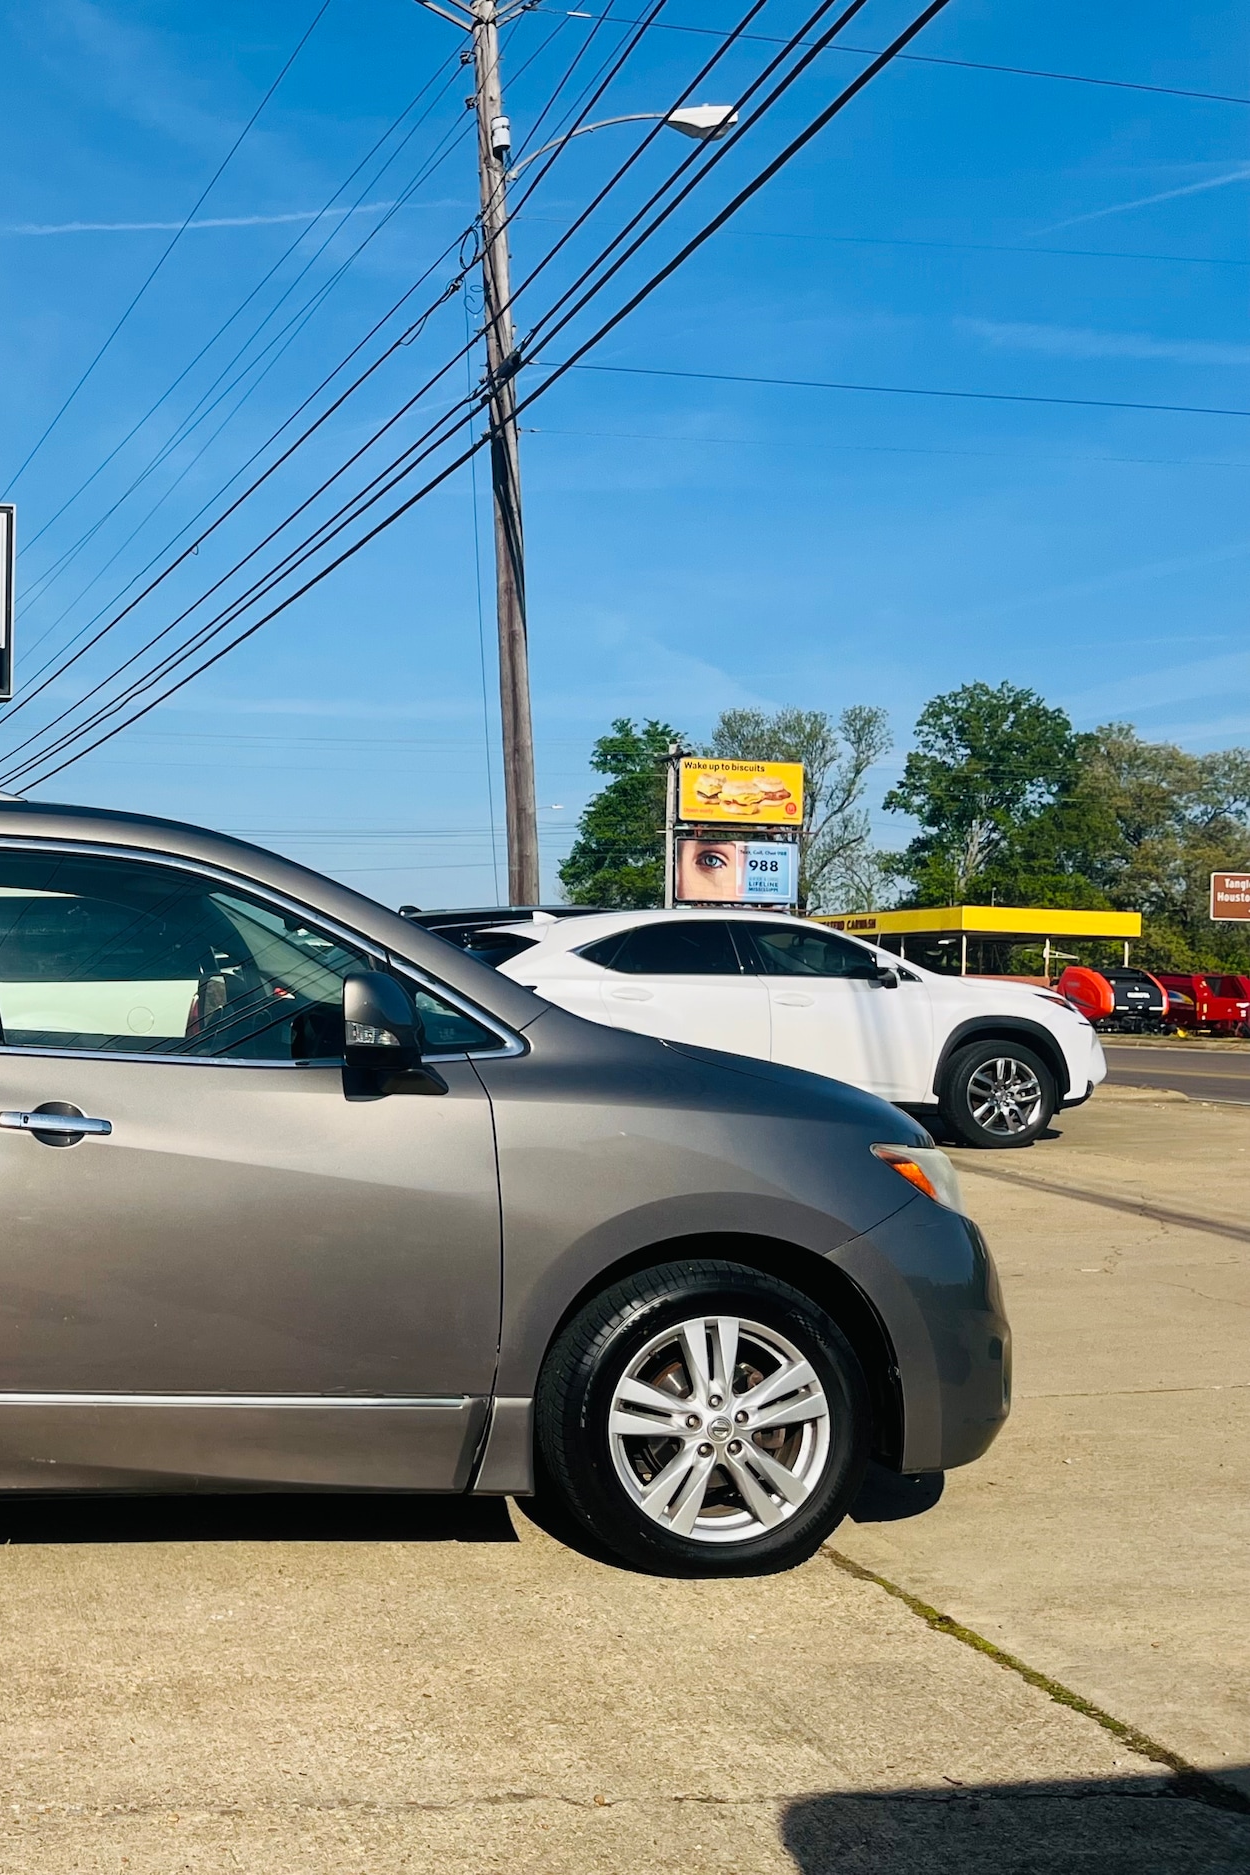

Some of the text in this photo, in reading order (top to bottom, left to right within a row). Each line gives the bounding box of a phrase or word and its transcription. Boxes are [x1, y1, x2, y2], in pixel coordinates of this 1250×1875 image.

[684, 761, 765, 772] Wake up to biscuits
[748, 859, 779, 872] 988
[1224, 878, 1250, 891] Tangl
